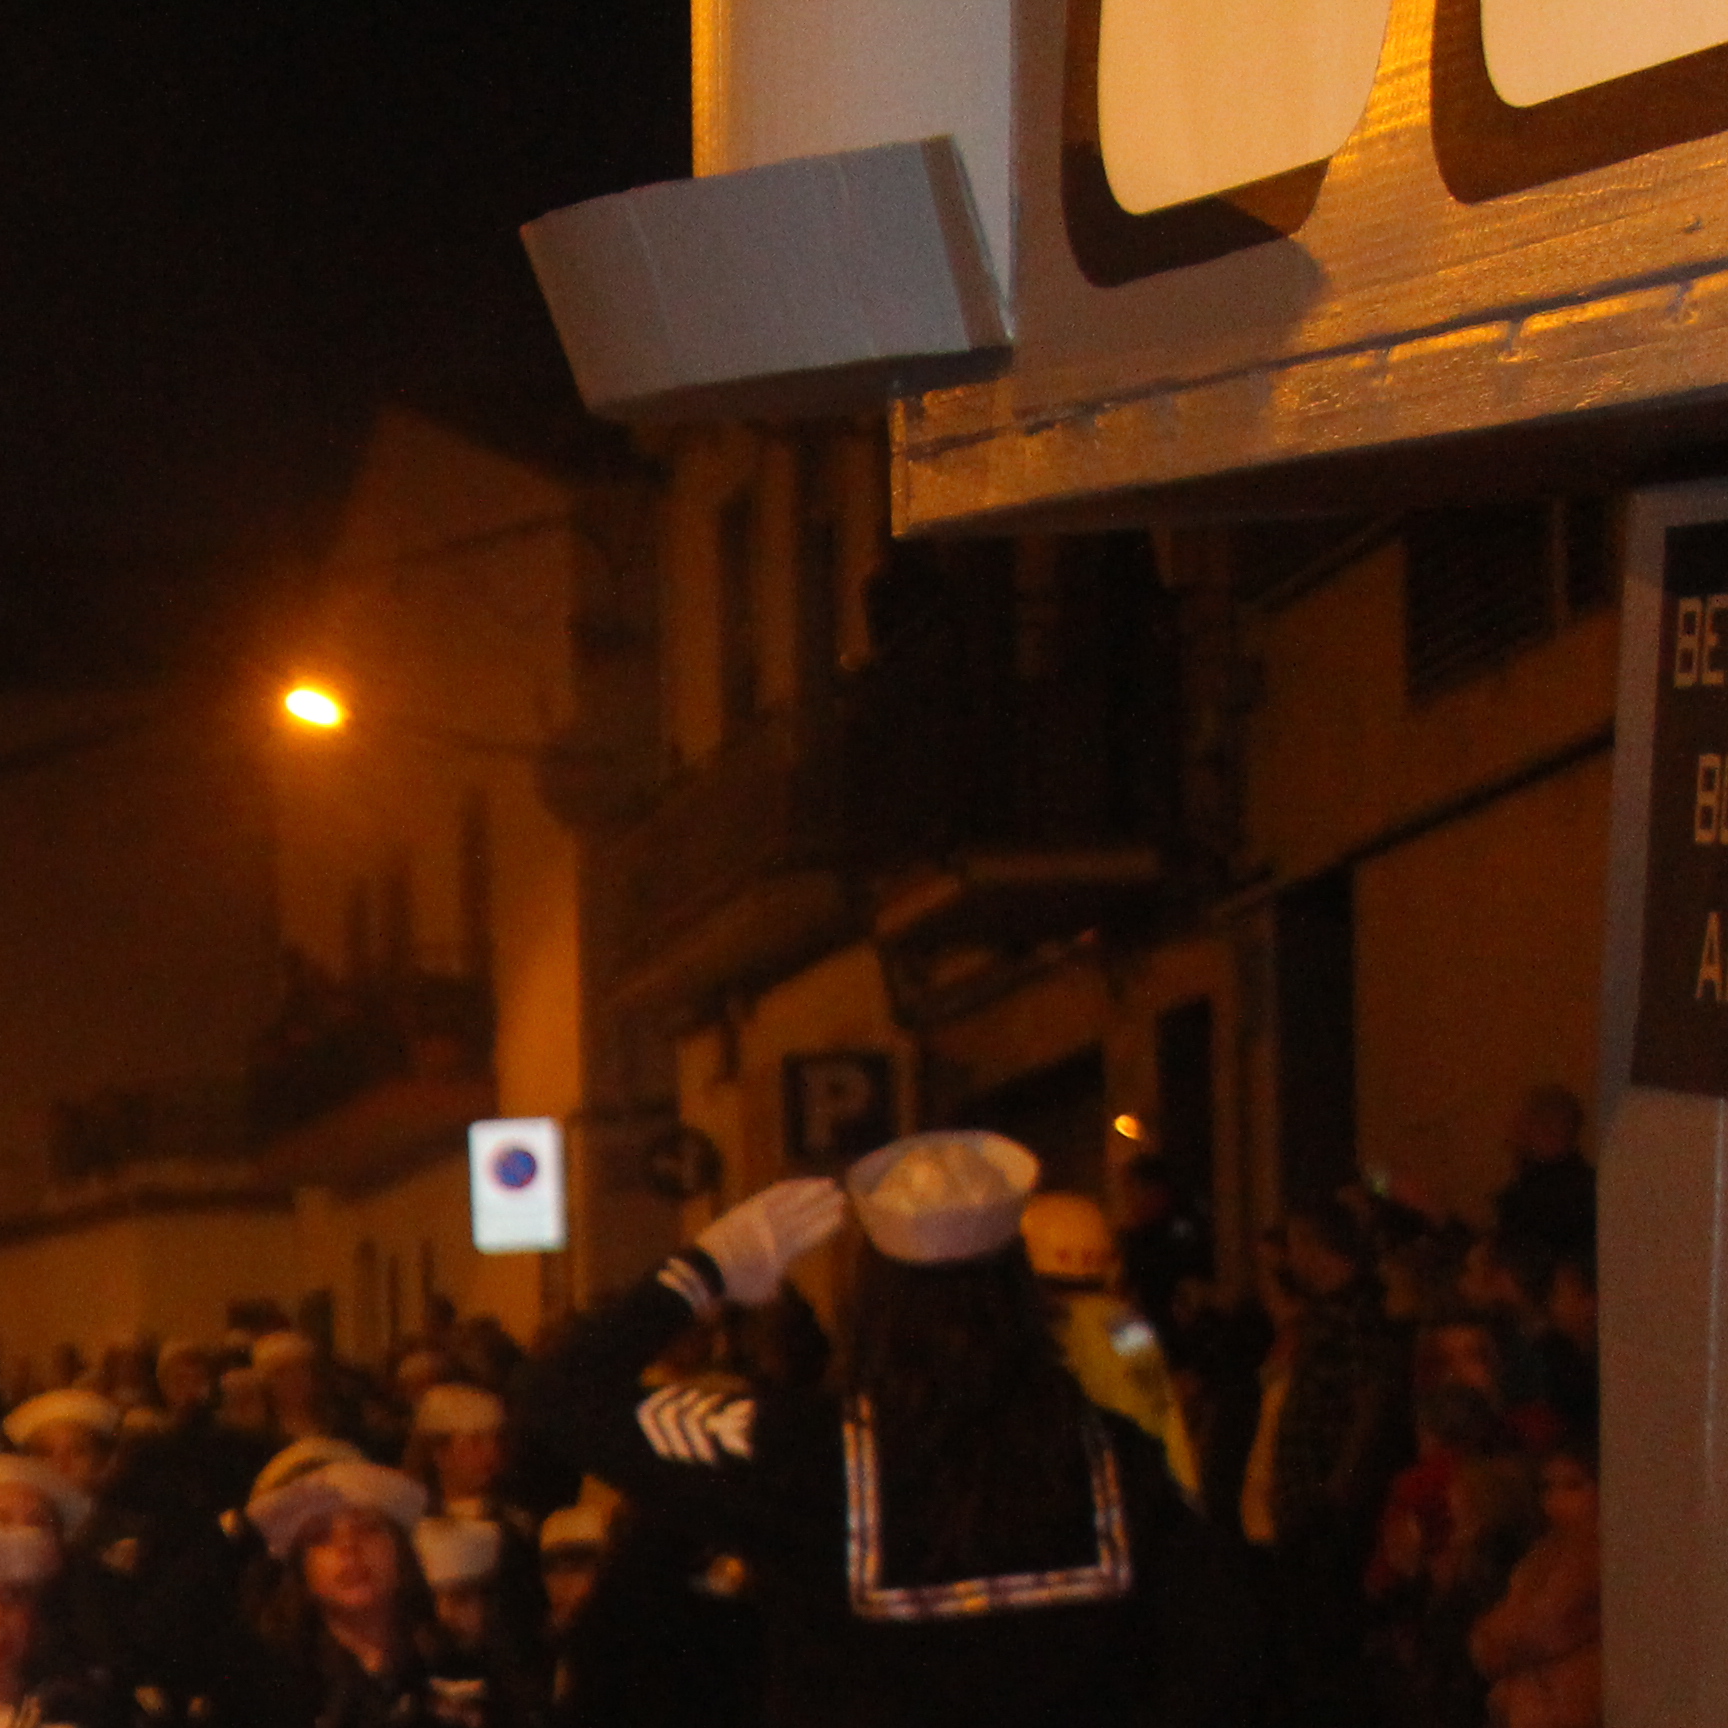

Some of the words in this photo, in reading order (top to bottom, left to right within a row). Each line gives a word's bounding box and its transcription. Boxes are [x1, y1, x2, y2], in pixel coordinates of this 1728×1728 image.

[1695, 752, 1728, 845] B
[1694, 910, 1728, 1003] A
[802, 1063, 869, 1147] P
